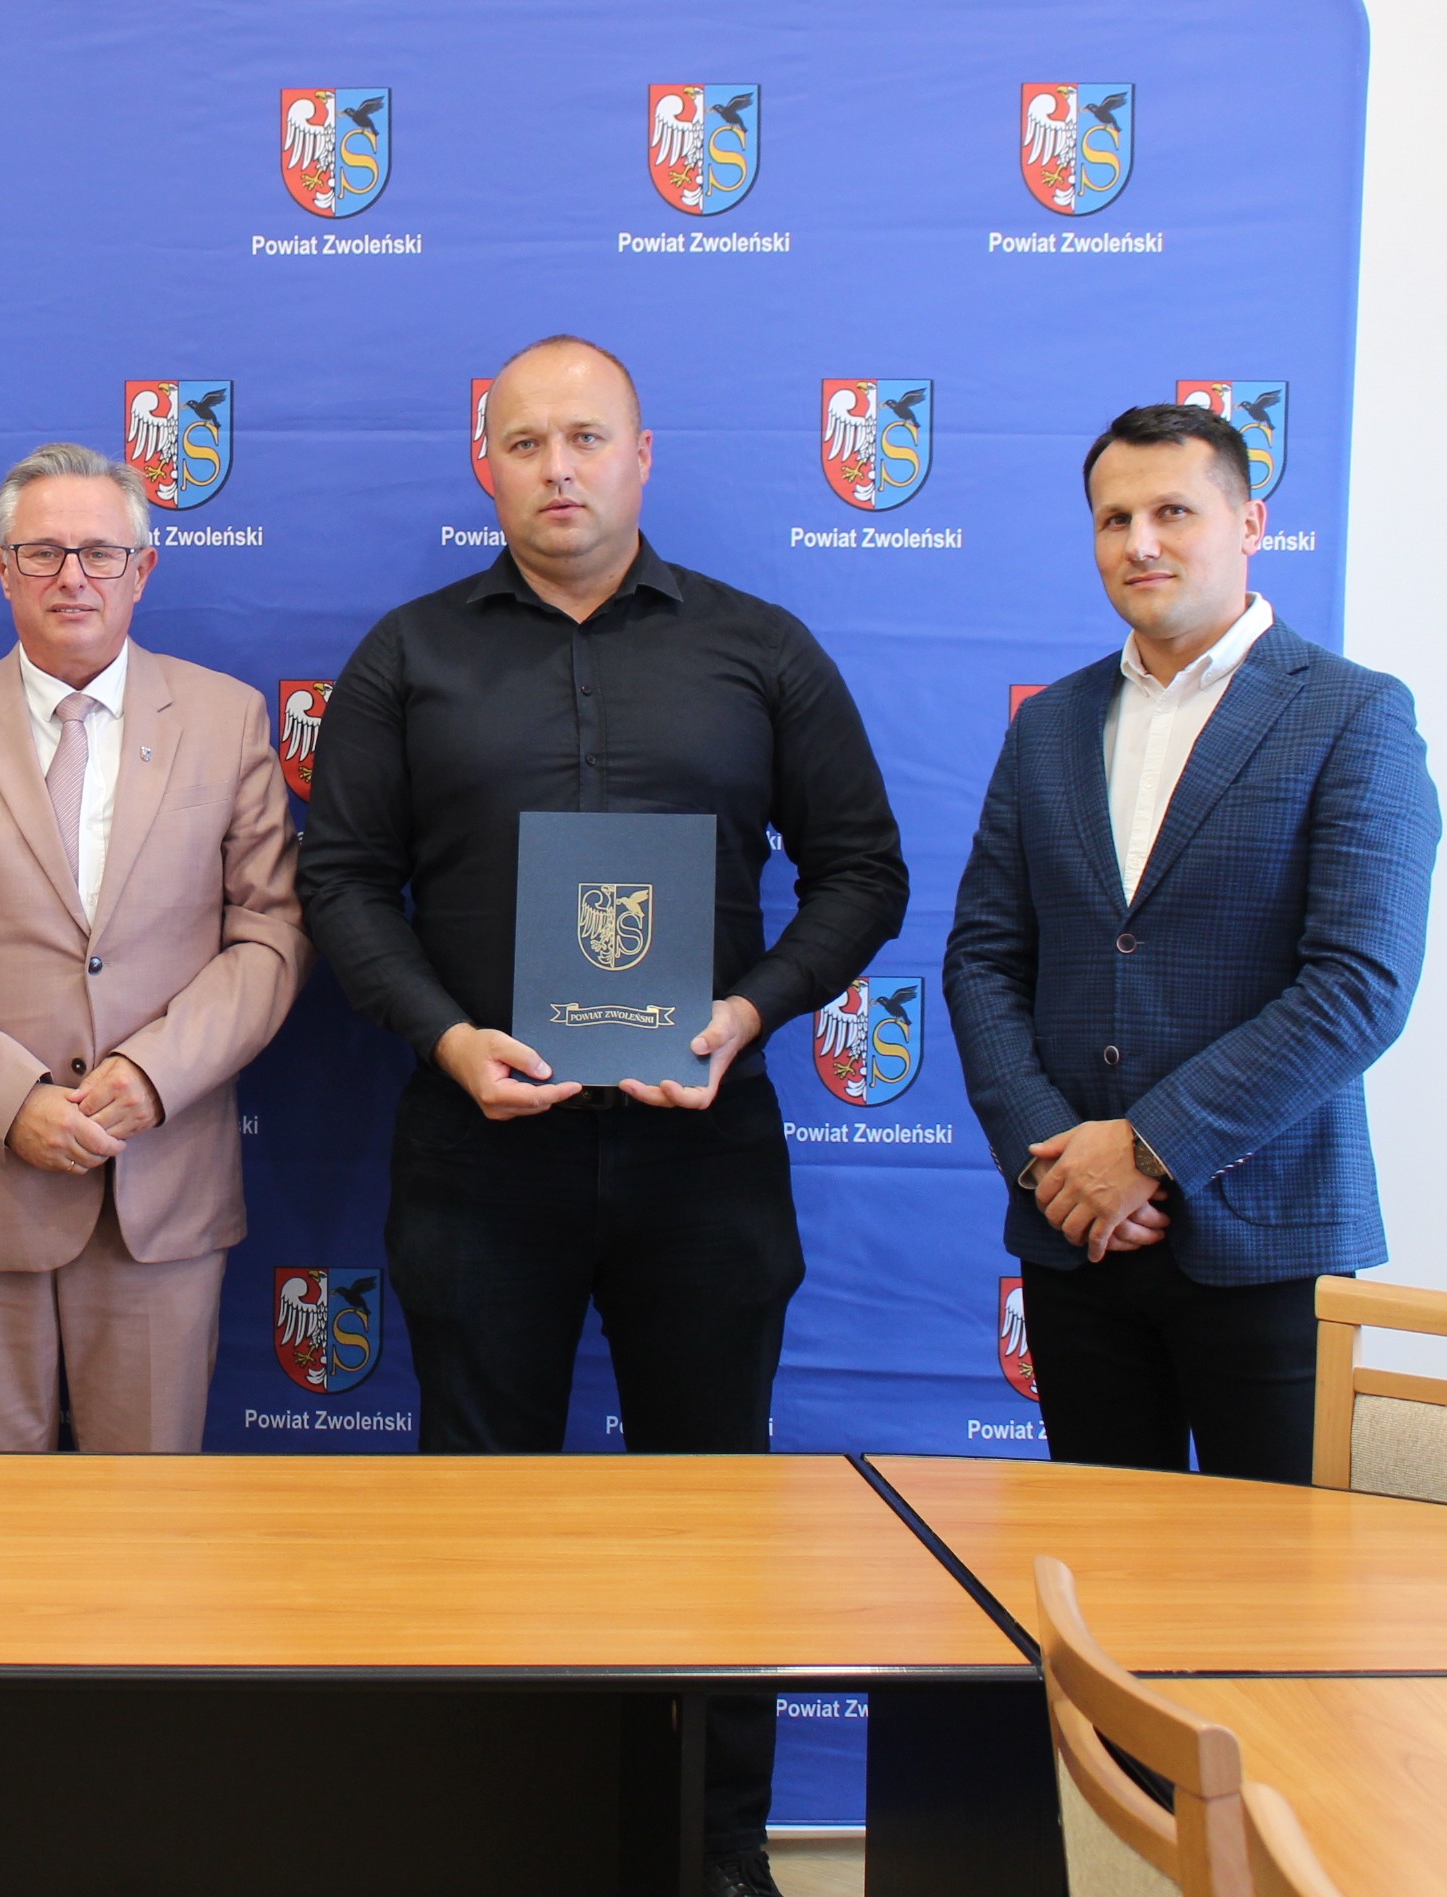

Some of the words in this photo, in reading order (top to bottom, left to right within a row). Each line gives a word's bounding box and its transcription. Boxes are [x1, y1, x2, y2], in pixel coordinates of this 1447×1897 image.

[252, 235, 318, 256] Powiat
[322, 233, 422, 255] Zwoleński
[618, 232, 686, 253] Powiat
[689, 231, 791, 253] Zwoleński
[989, 231, 1057, 253] Powiat
[1060, 231, 1163, 253] Zwoleński
[165, 525, 263, 546] Zwoleński
[441, 525, 508, 546] Powiat
[791, 527, 858, 548] Powiat
[861, 527, 963, 549] Zwoleński
[570, 1010, 603, 1022] POWIAT
[604, 1010, 655, 1024] ZWOLEŃSKI
[783, 1122, 849, 1143] Powiat
[853, 1122, 953, 1144] Zwoleński
[245, 1409, 310, 1430] Powiat
[314, 1410, 412, 1432] Zwoleński
[968, 1419, 1034, 1440] Powiat
[776, 1698, 840, 1718] Powiat
